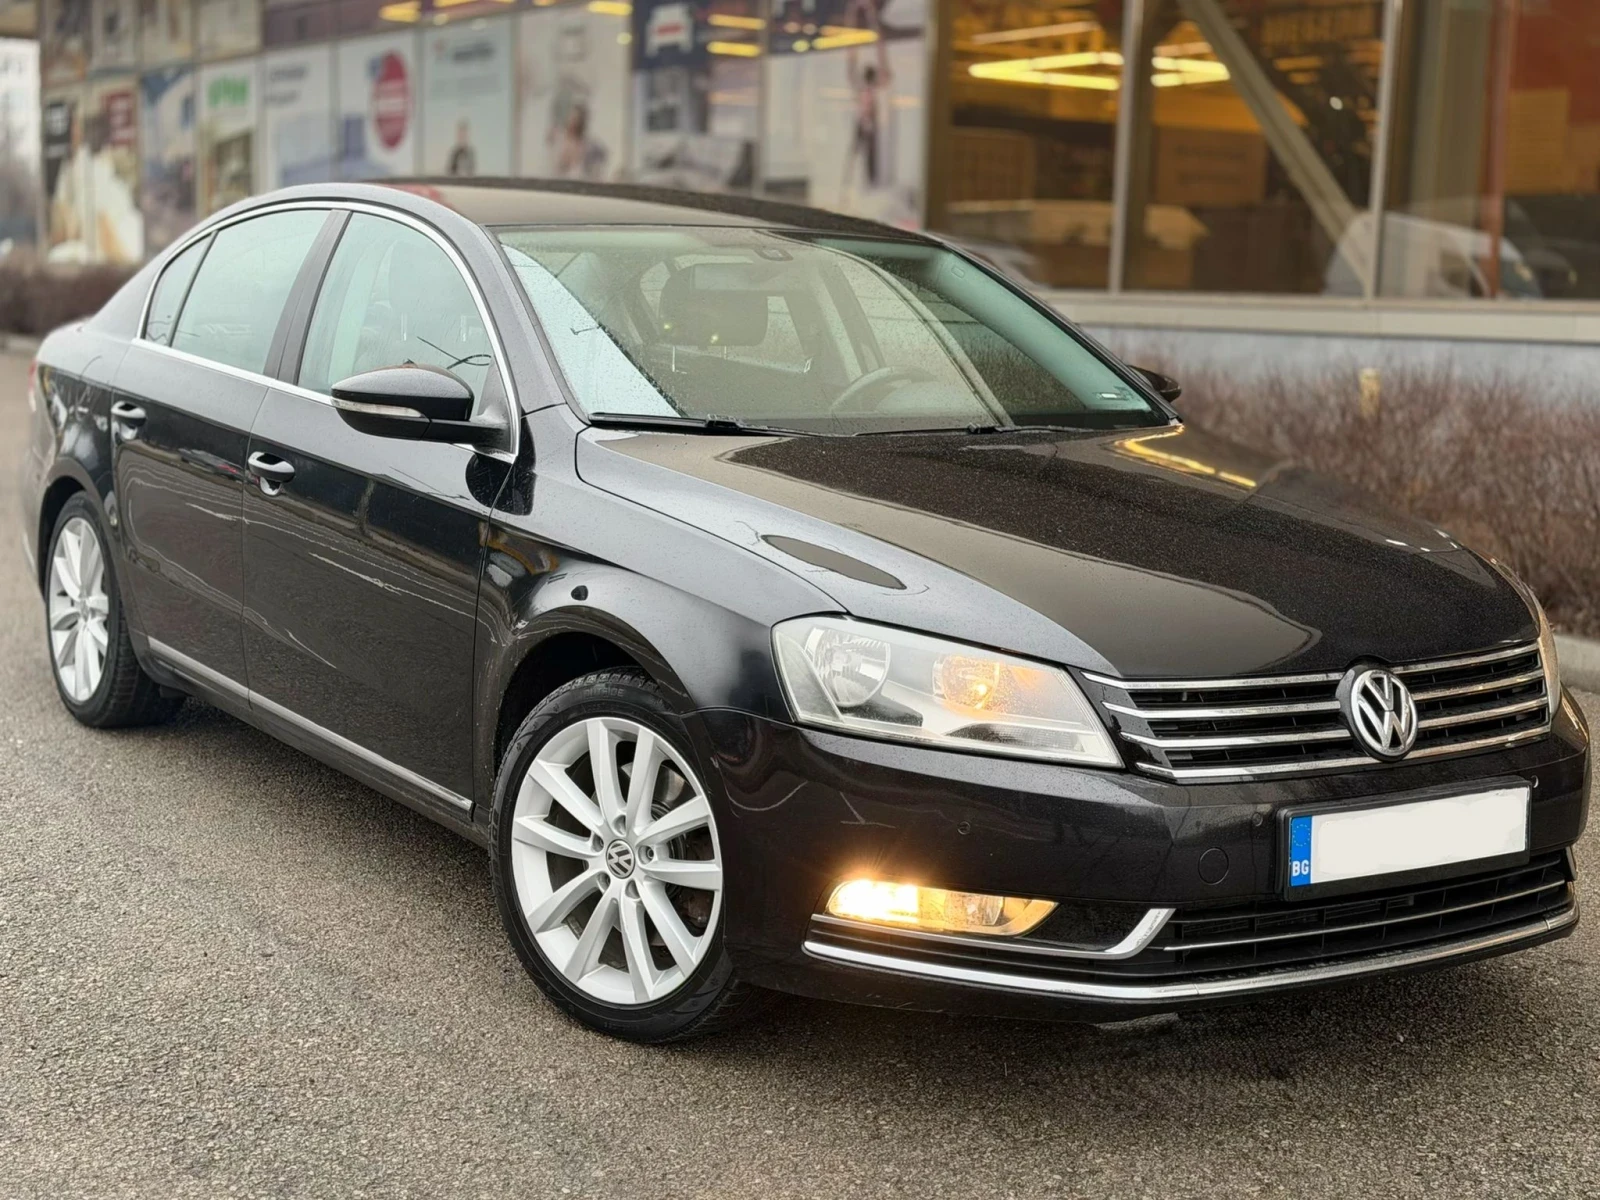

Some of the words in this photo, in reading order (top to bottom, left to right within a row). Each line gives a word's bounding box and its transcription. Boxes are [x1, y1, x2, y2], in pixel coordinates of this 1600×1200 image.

[1354, 671, 1414, 754] VW
[607, 841, 634, 877] VW
[1292, 859, 1310, 877] BG
